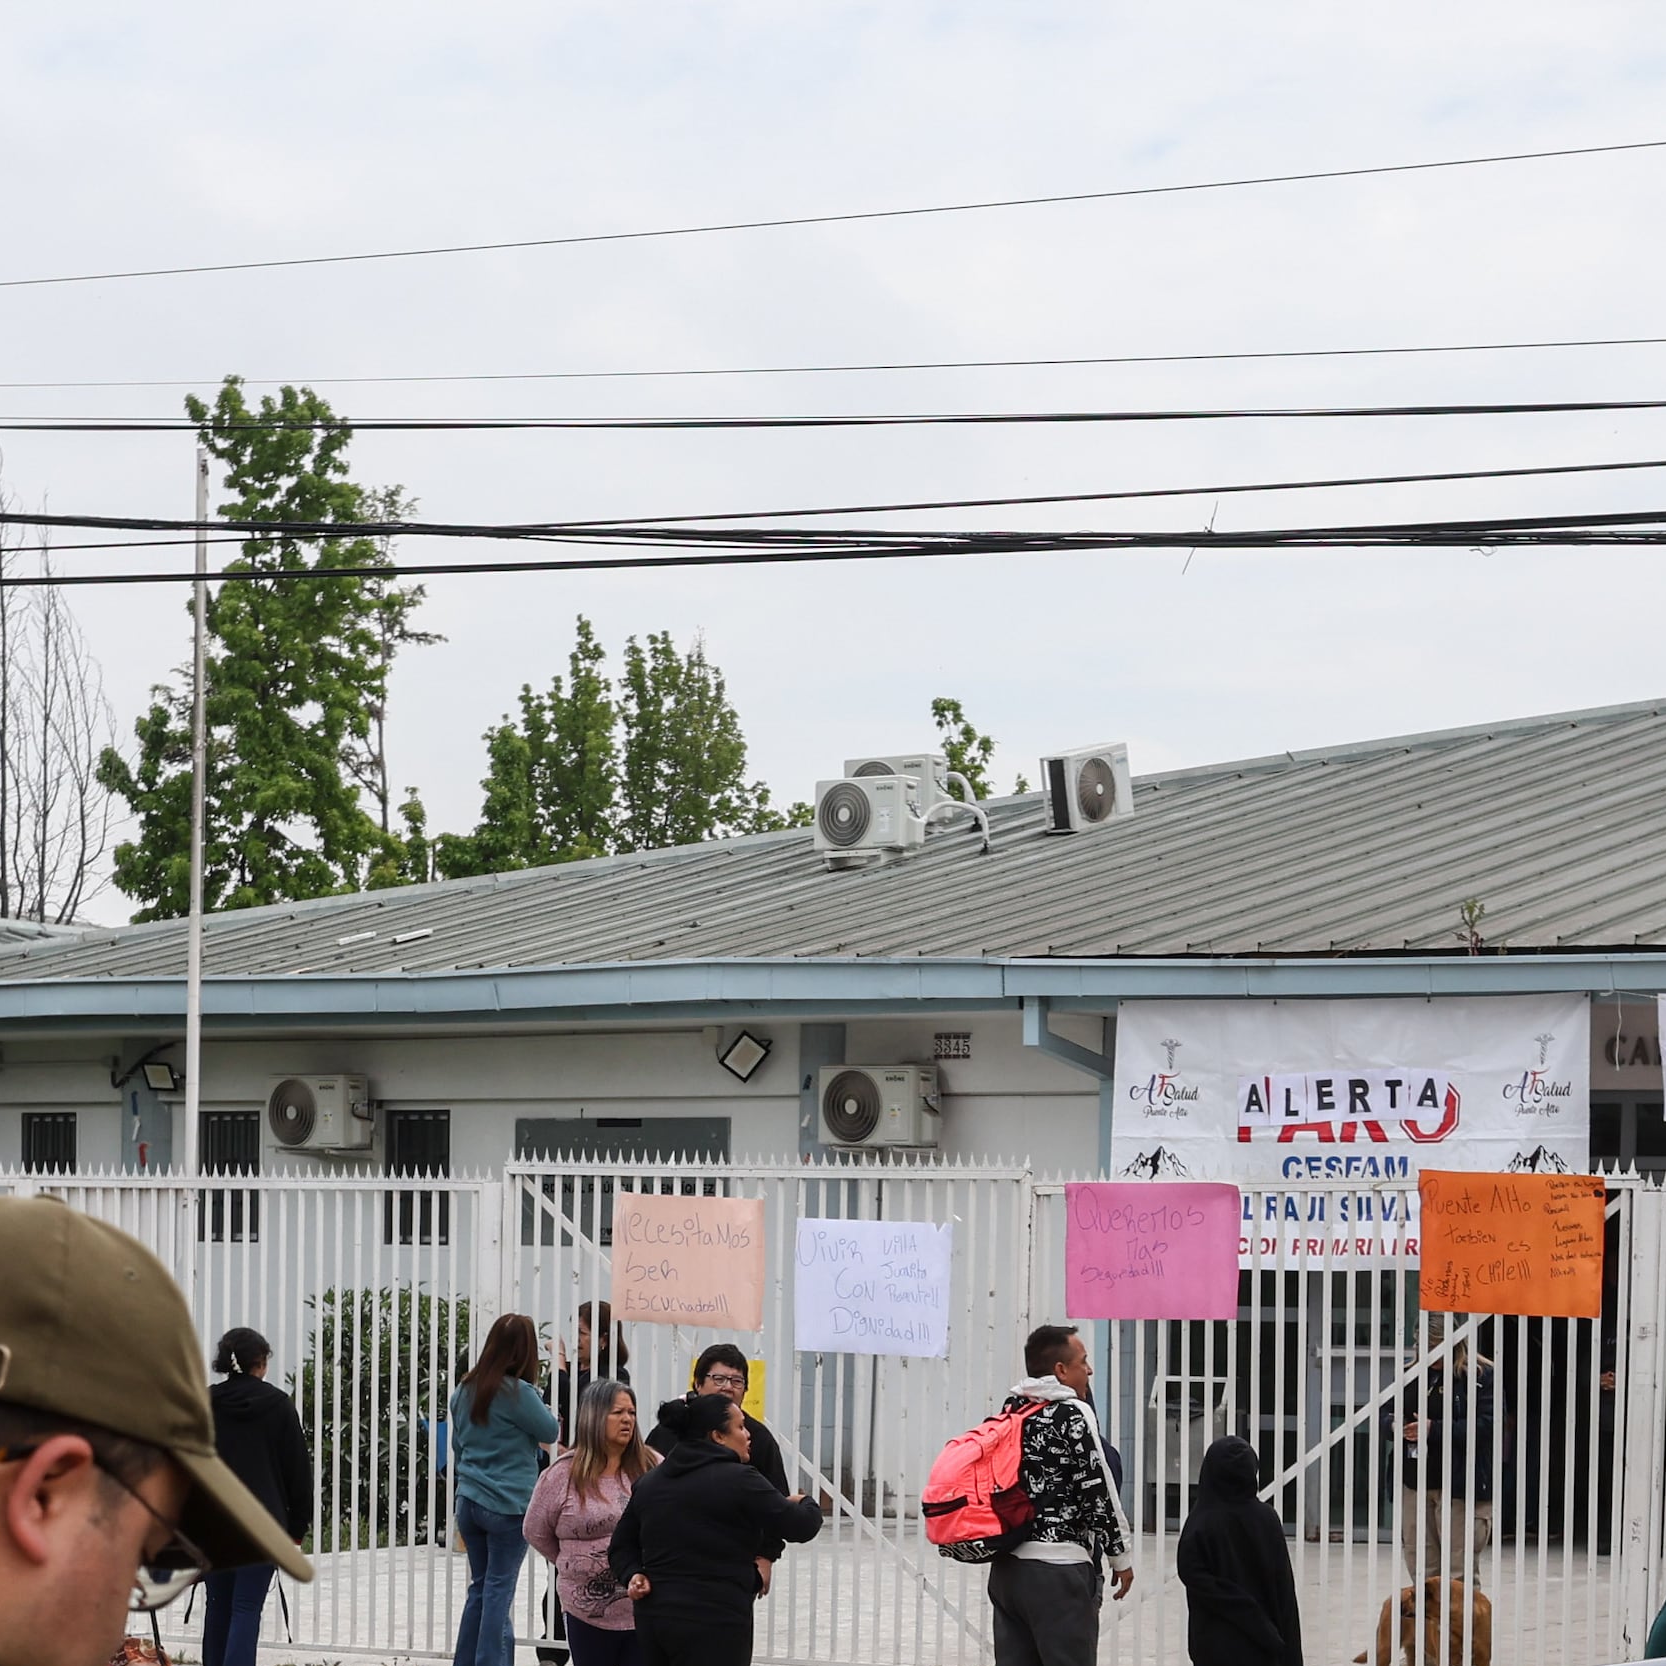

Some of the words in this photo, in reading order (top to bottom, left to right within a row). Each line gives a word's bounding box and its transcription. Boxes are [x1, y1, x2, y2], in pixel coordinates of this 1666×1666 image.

[935, 1039, 971, 1054] 3345
[1244, 1077, 1440, 1117] ALERTA
[1282, 1156, 1408, 1179] CESFAM
